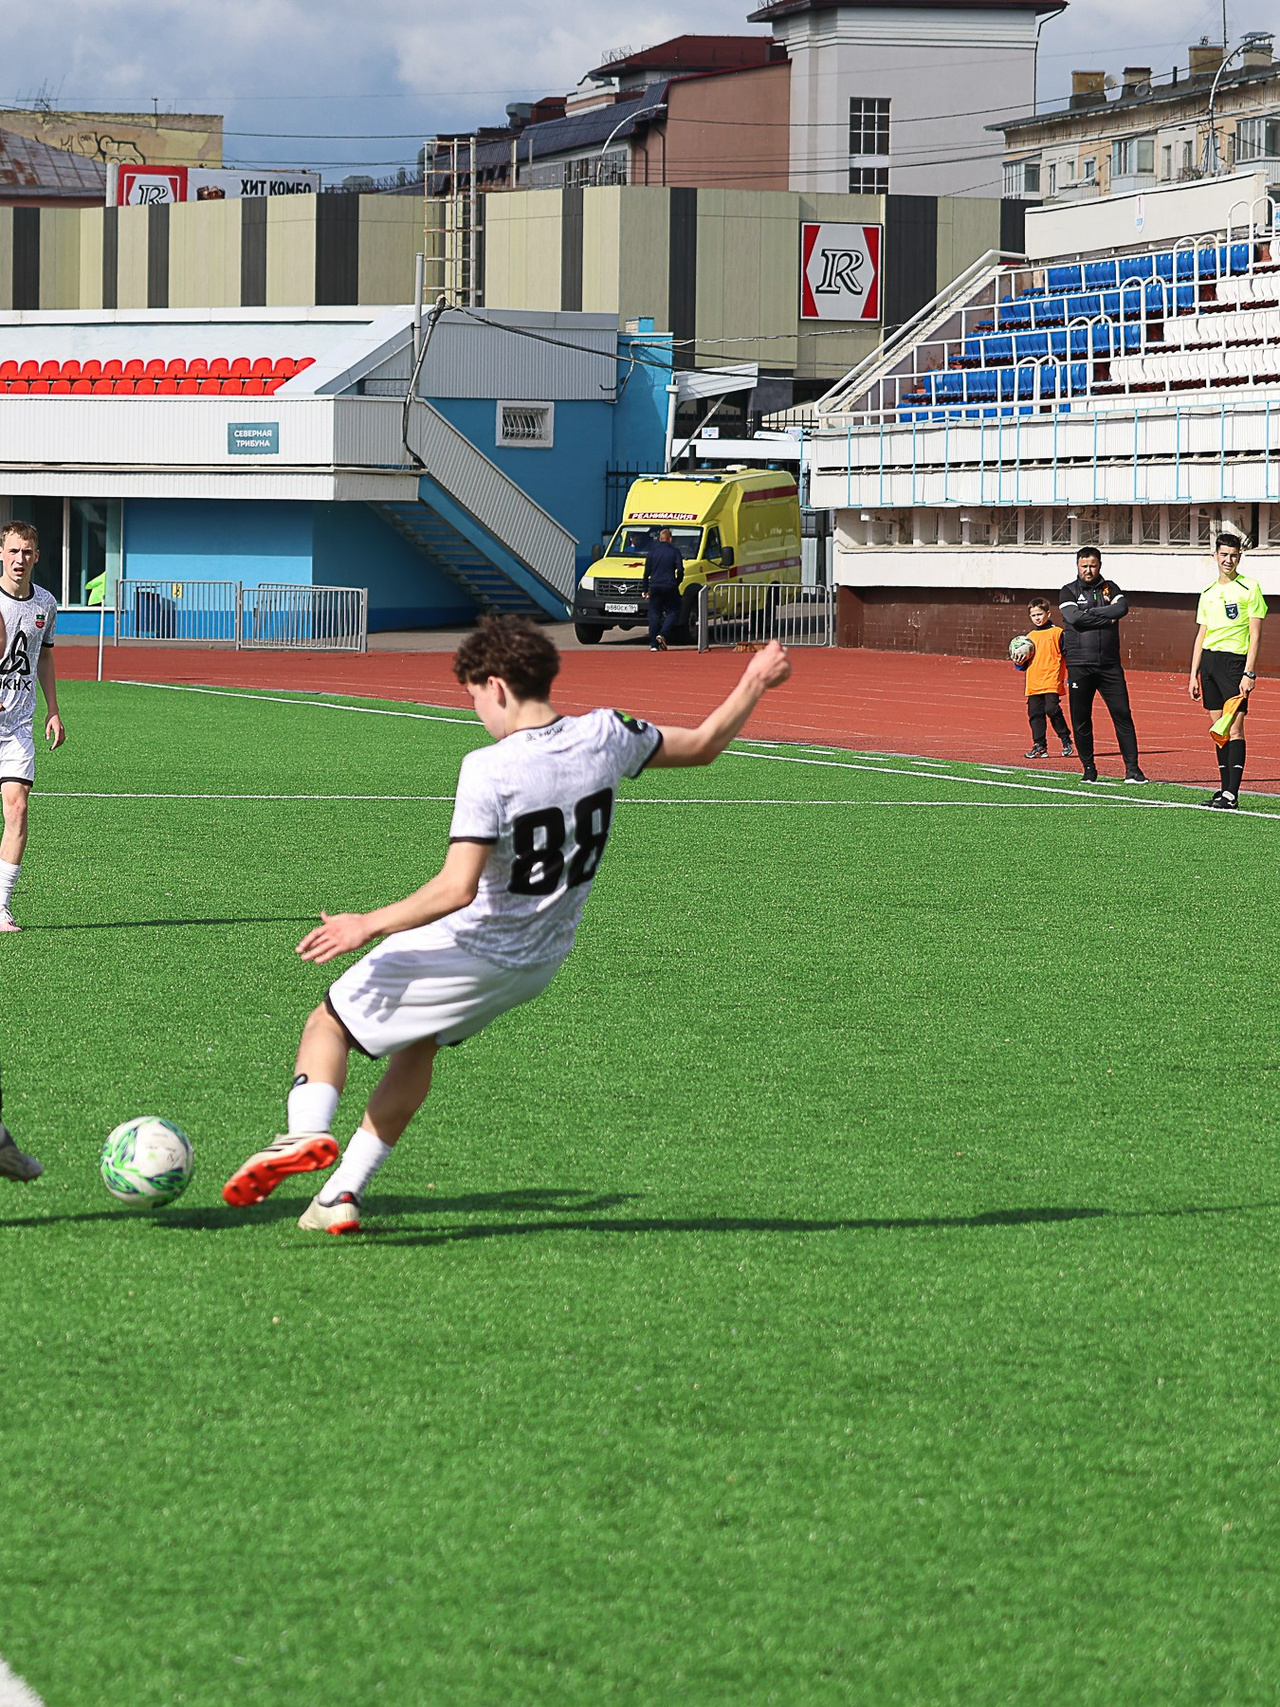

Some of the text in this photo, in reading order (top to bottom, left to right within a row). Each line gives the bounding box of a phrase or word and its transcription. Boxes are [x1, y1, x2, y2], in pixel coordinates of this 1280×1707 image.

[240, 179, 312, 196] ХИТ КОМБО
[814, 248, 865, 296] R
[233, 429, 273, 438] СЕВЕРНАЯ
[235, 439, 271, 448] ТРИБУНА
[631, 512, 694, 520] РЕАНИМАЦИЯ
[507, 787, 614, 896] 88
